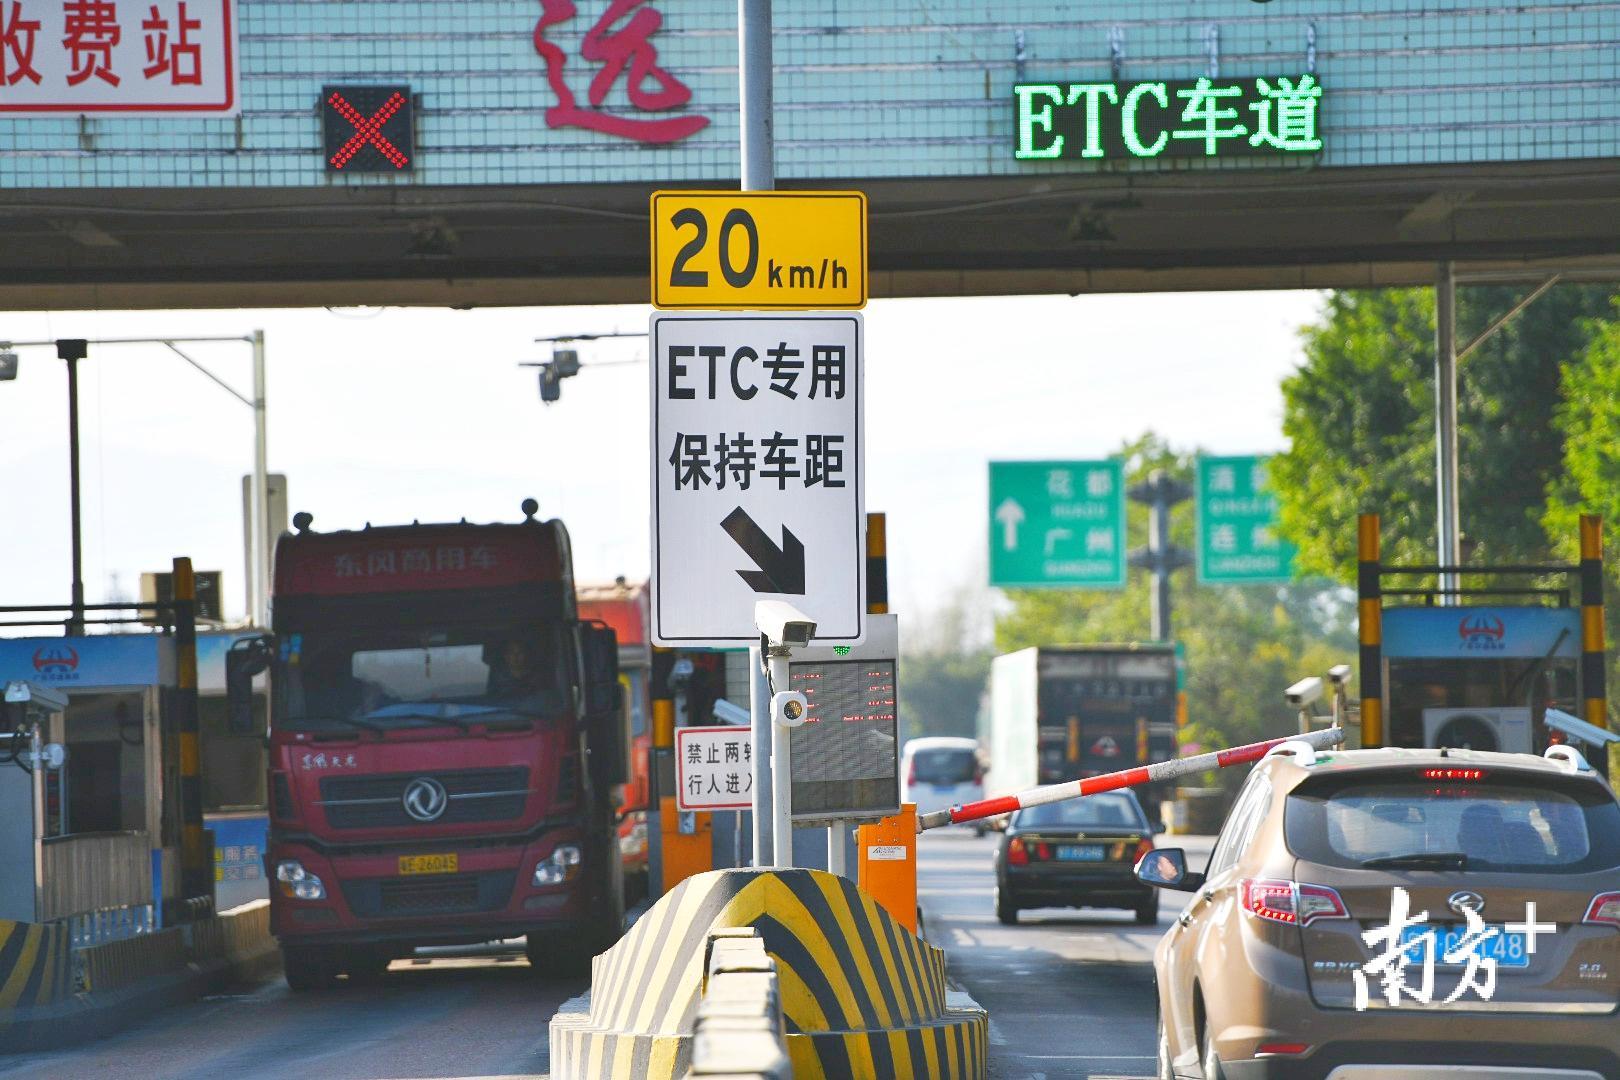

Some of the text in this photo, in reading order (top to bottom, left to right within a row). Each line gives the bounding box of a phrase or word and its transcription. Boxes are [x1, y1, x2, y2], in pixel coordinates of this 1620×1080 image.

[0, 0, 202, 87] 收费站
[1014, 74, 1323, 159] ETC车道
[669, 207, 848, 289] 20 km/h
[668, 341, 846, 400] ETC专用
[668, 430, 846, 491] 保持车距
